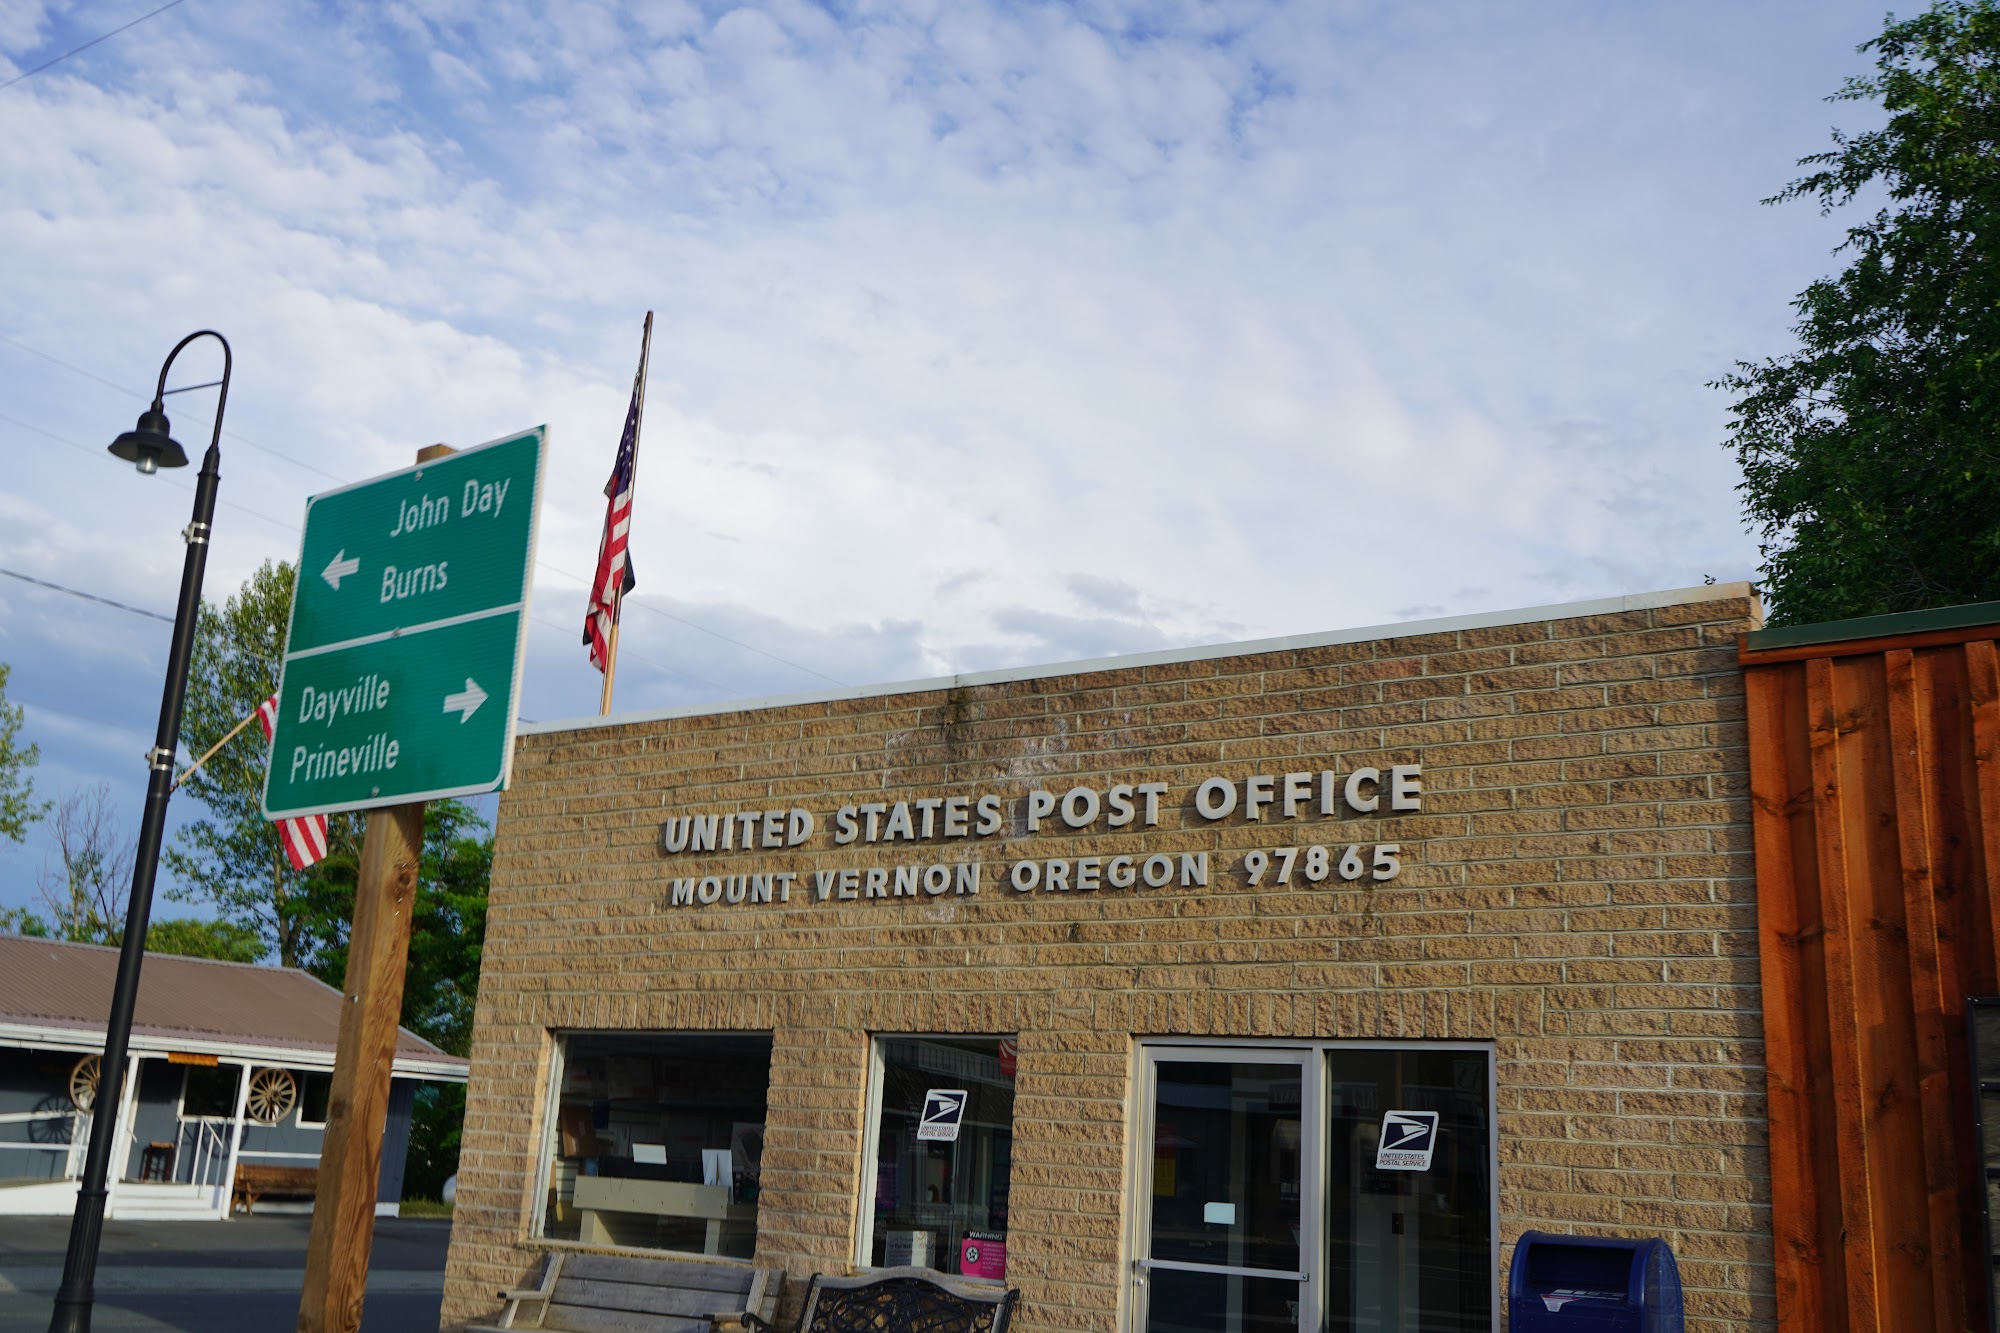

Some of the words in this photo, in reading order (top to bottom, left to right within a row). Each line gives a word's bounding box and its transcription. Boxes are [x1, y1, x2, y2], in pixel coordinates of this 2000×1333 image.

[390, 494, 450, 538] John
[461, 477, 511, 519] Day
[380, 560, 449, 604] Burns
[298, 673, 390, 729] Dayville
[289, 731, 400, 784] Prineville
[665, 807, 814, 854] UNITED
[834, 794, 1003, 845] STATES
[1028, 781, 1168, 832] POST
[1195, 763, 1422, 820] OFFICE
[671, 871, 797, 906] MOUNT
[814, 862, 981, 901] VERNON
[1011, 851, 1209, 893] OREGON
[1244, 843, 1400, 886] 97865
[969, 1230, 1003, 1241] WARNING
